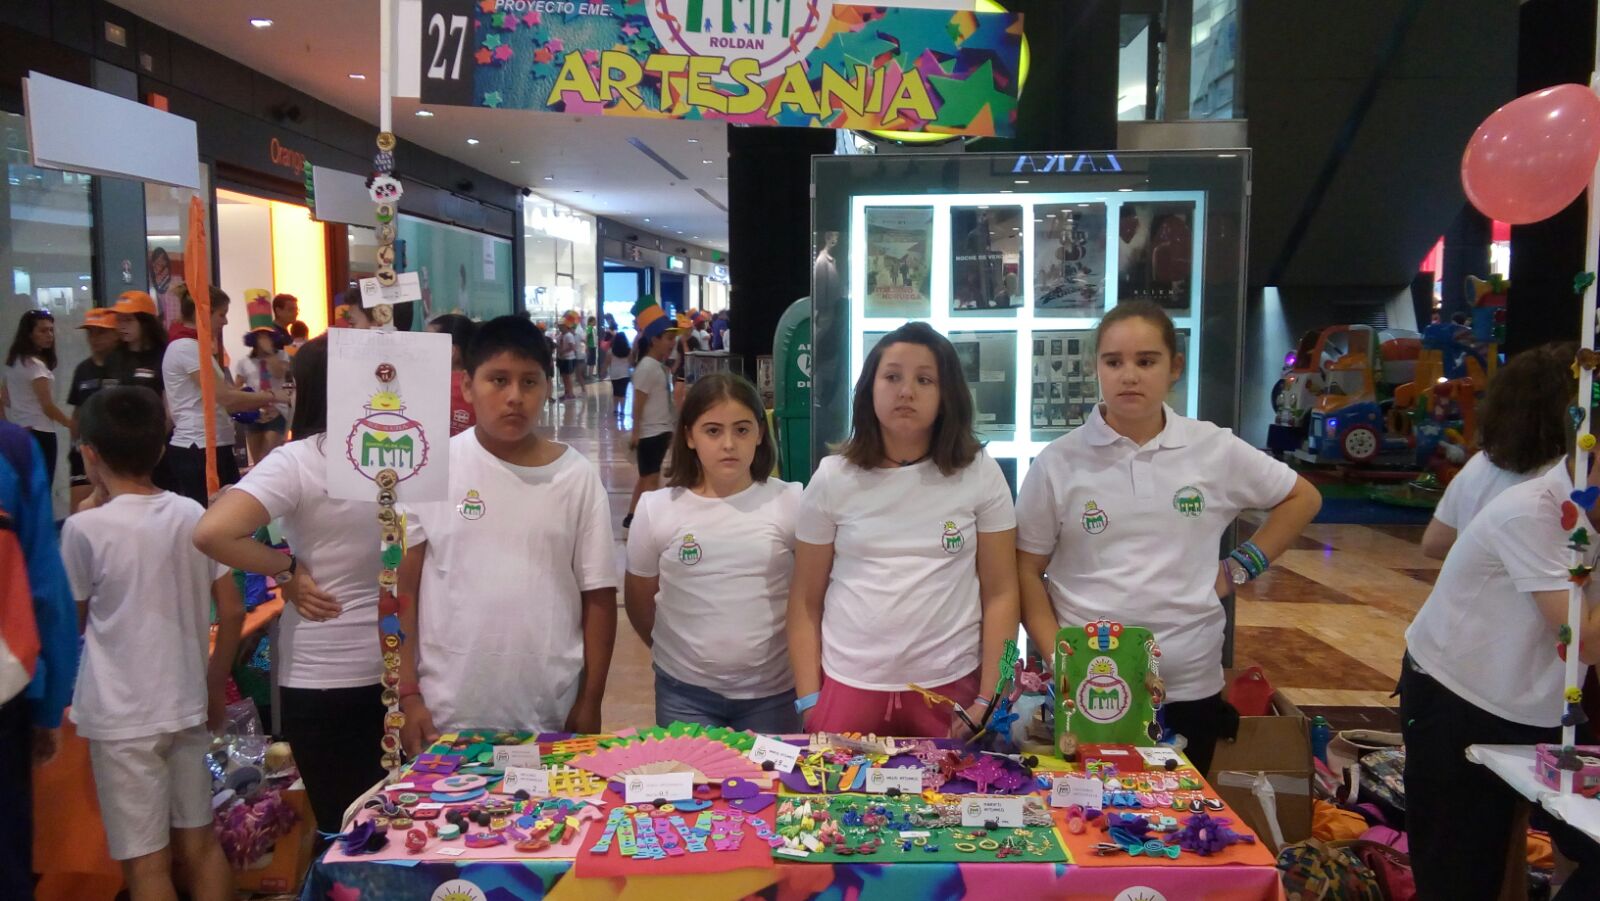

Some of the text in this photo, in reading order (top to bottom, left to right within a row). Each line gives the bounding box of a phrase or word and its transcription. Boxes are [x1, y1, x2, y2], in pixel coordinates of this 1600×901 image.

[494, 0, 614, 16] PROYECTO EME:
[427, 14, 468, 80] 27
[709, 36, 765, 50] ROLDAN
[546, 50, 938, 123] ARTESANIA
